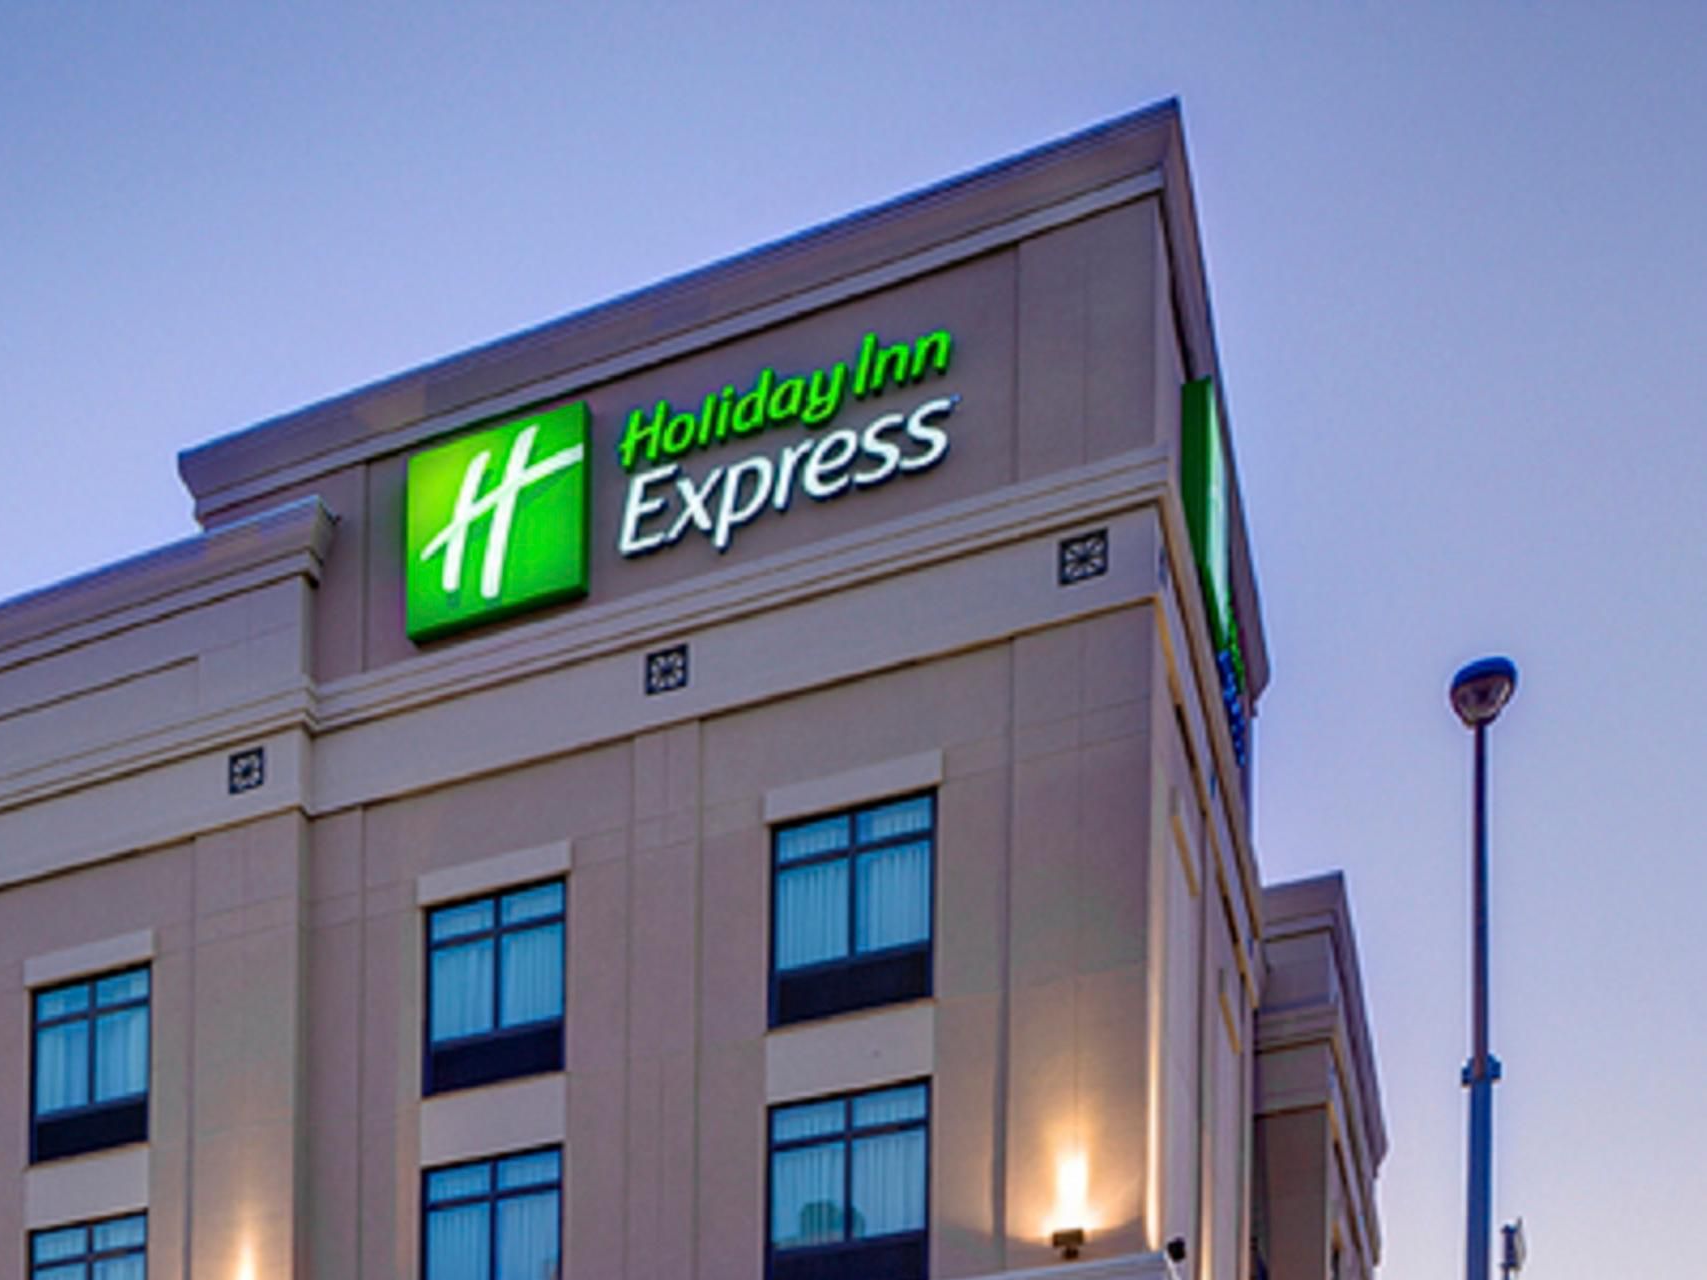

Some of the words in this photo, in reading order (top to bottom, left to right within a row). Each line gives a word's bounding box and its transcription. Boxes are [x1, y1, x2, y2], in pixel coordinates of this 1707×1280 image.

[619, 361, 846, 468] Holiday
[851, 329, 952, 395] Inn
[619, 398, 954, 554] Express
